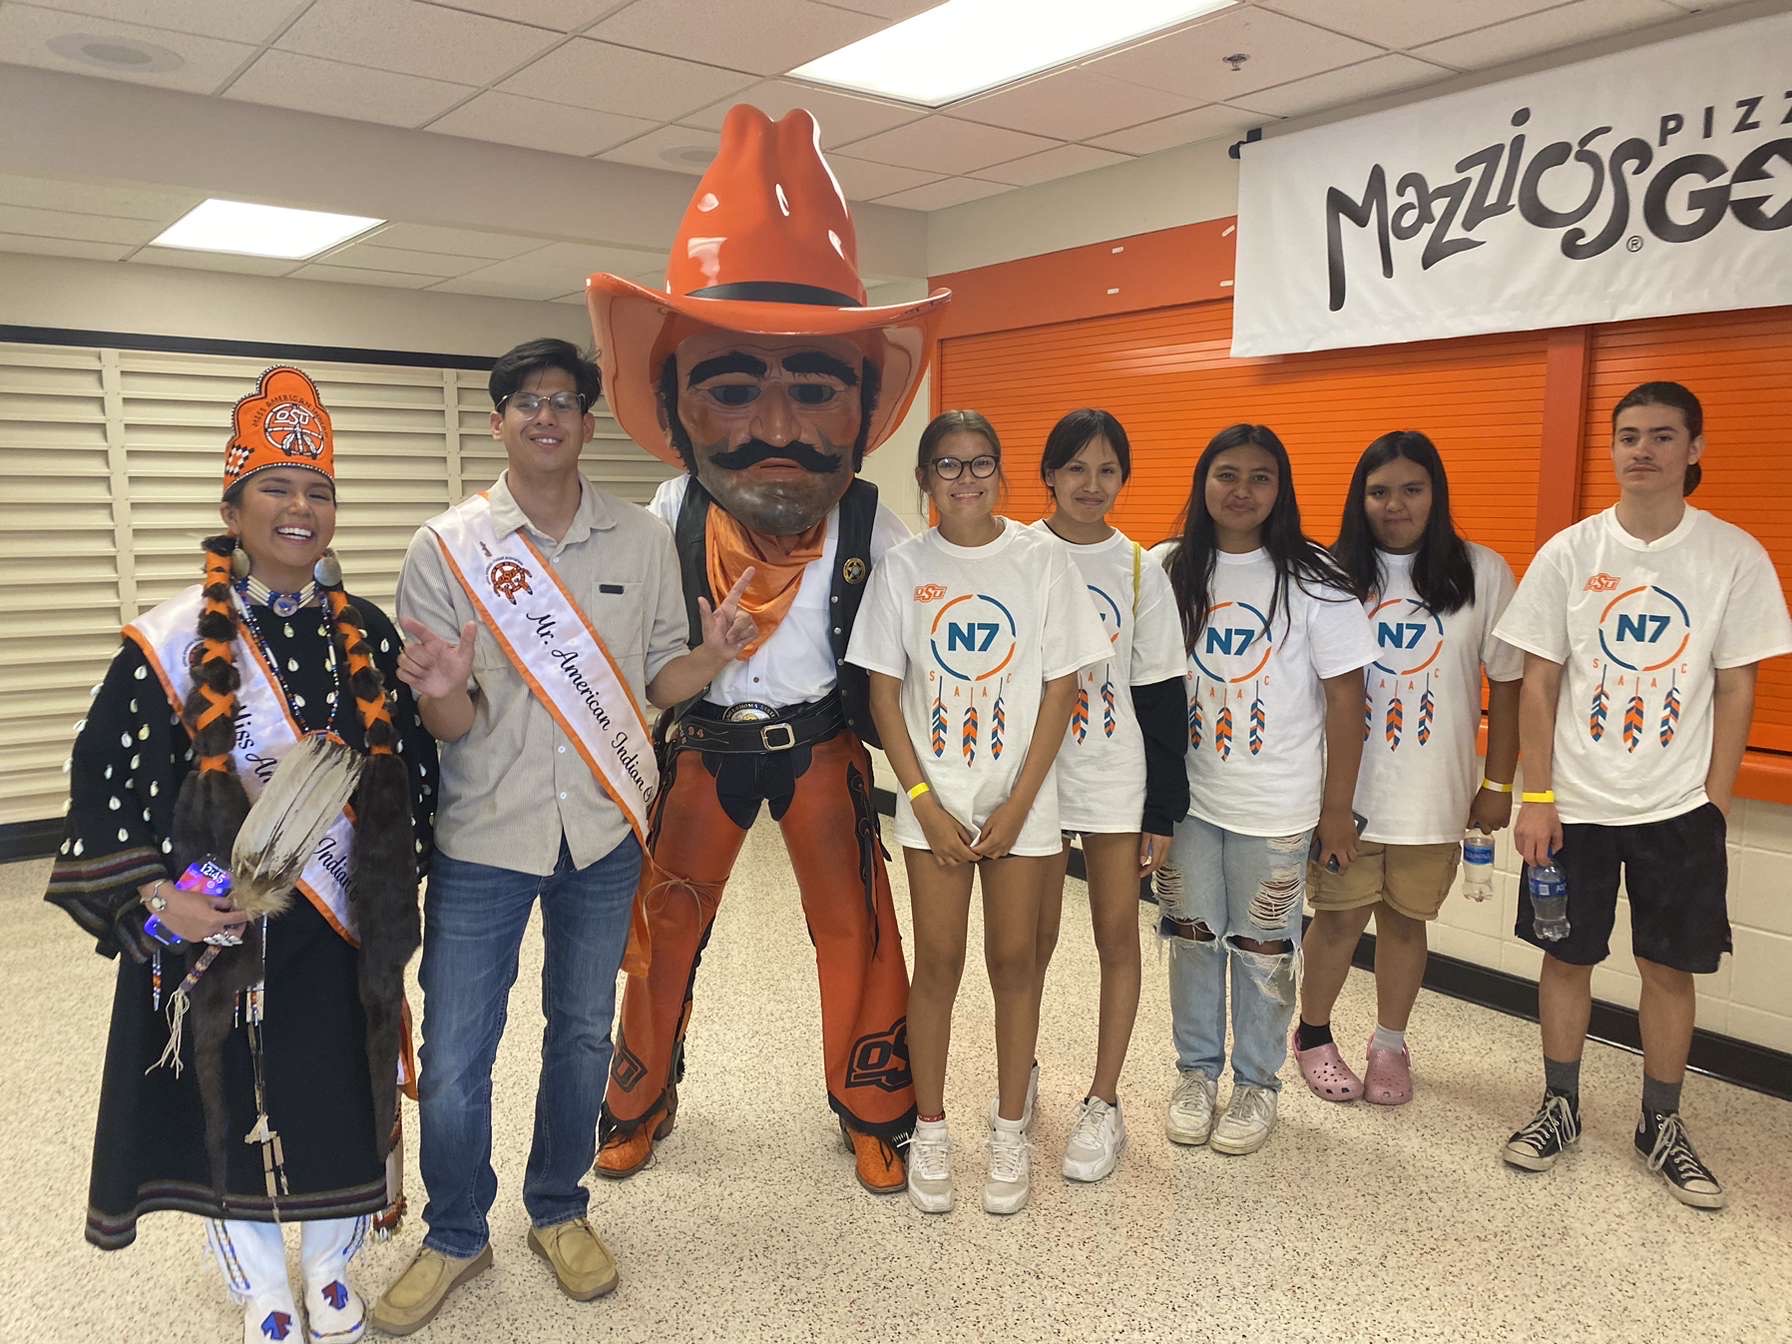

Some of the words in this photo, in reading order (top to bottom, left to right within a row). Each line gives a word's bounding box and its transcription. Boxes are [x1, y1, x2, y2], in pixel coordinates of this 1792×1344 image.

[274, 408, 309, 425] OSU
[947, 622, 1000, 652] N7
[1206, 626, 1255, 656] N7
[1378, 622, 1427, 649] N7
[1615, 613, 1671, 643] N7
[526, 613, 556, 645] Mr.
[551, 649, 610, 731] American
[611, 731, 644, 791] Indian
[200, 863, 226, 884] 12:45
